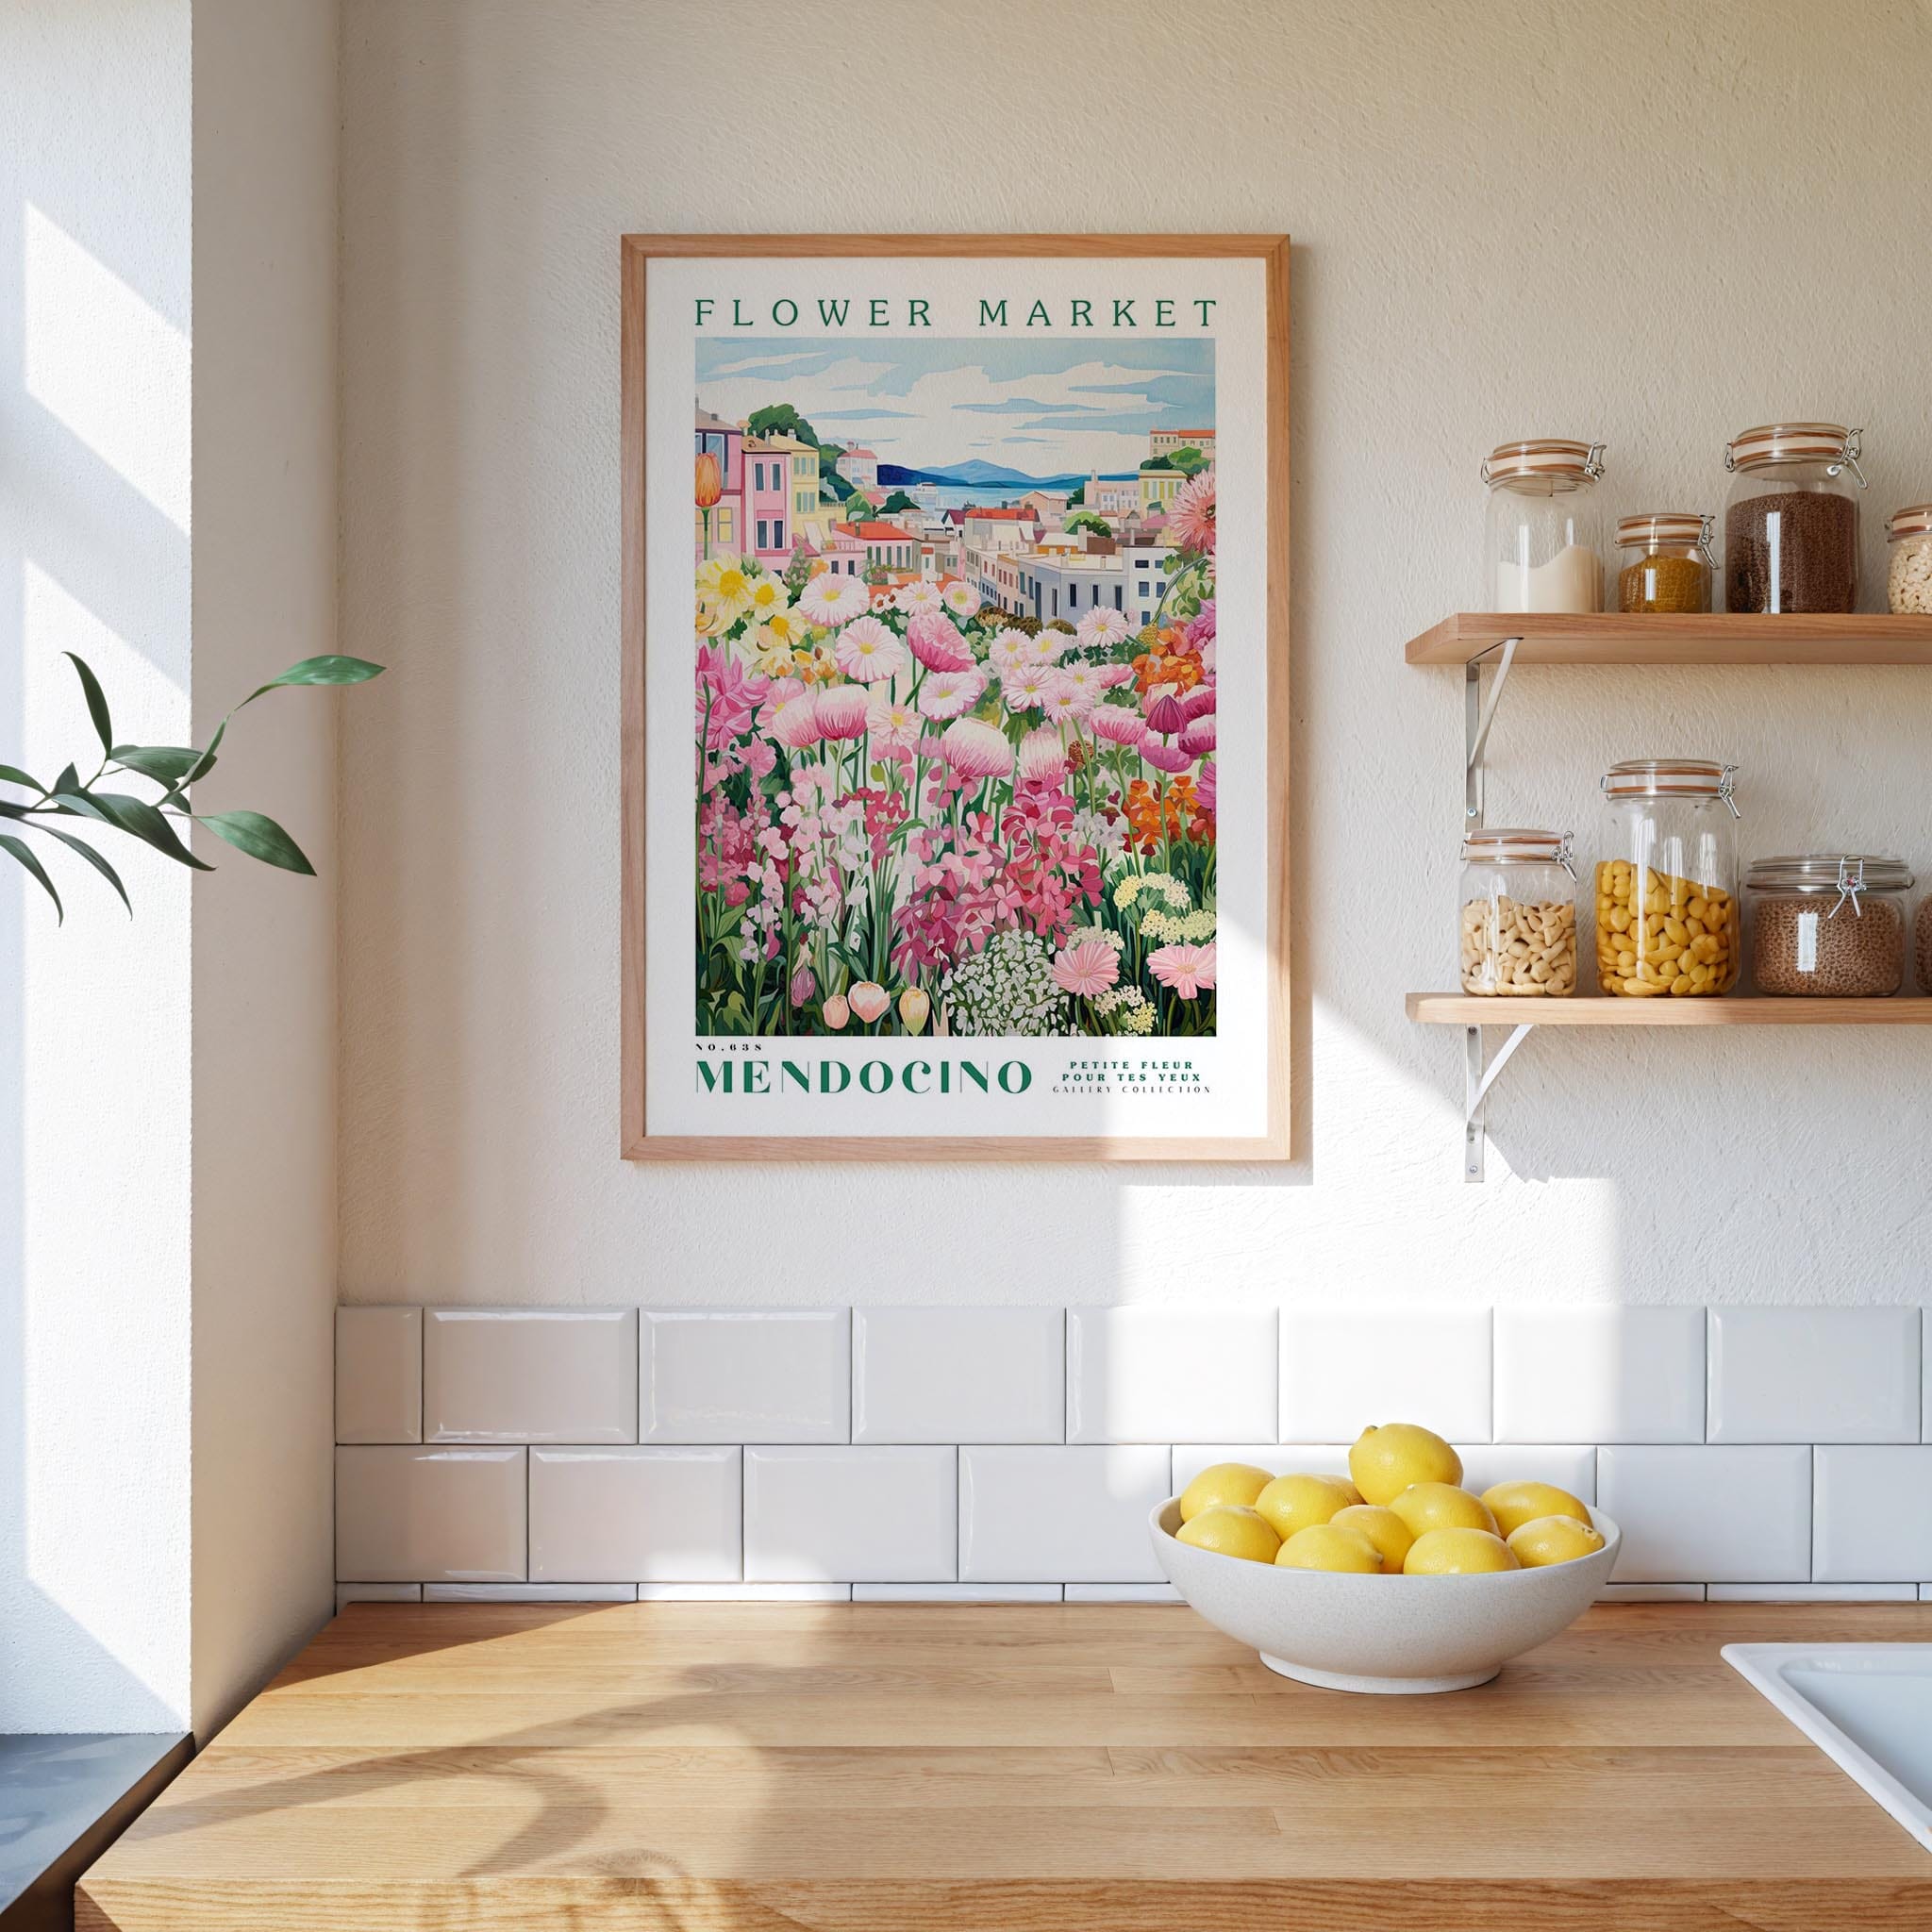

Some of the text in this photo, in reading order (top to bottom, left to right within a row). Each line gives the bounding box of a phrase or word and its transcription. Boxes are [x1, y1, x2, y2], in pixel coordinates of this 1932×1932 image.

[695, 299, 1217, 327] FLOWER MARKET
[1070, 1061, 1193, 1070] PETITE FLEUR
[696, 1059, 1033, 1094] MENDOCINO
[1062, 1074, 1201, 1082] POUR TES YEUX
